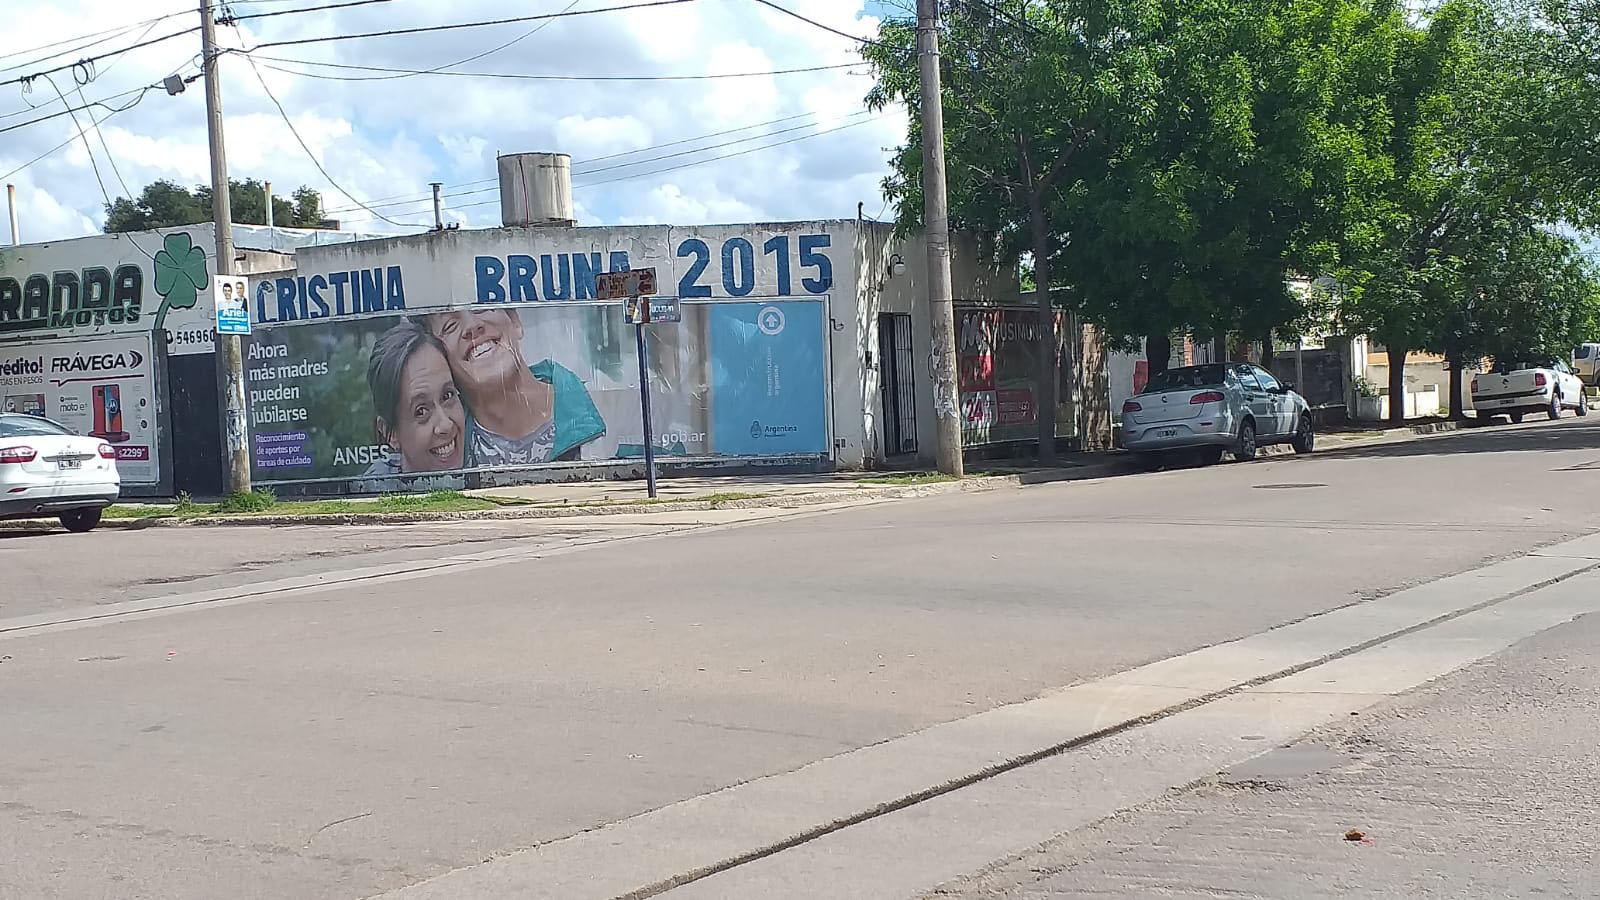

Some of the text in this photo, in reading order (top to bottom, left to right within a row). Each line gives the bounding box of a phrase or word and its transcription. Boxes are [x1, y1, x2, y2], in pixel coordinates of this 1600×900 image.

[257, 266, 405, 323] CRISTINA
[677, 234, 833, 298] 2015
[50, 305, 141, 328] MOTOS
[248, 342, 288, 359] Ahora
[51, 352, 126, 373] FRÁVEGA
[249, 359, 328, 380] más madres
[250, 384, 299, 406] pueden
[251, 405, 308, 428] jubilarse
[333, 445, 390, 466] ANSES
